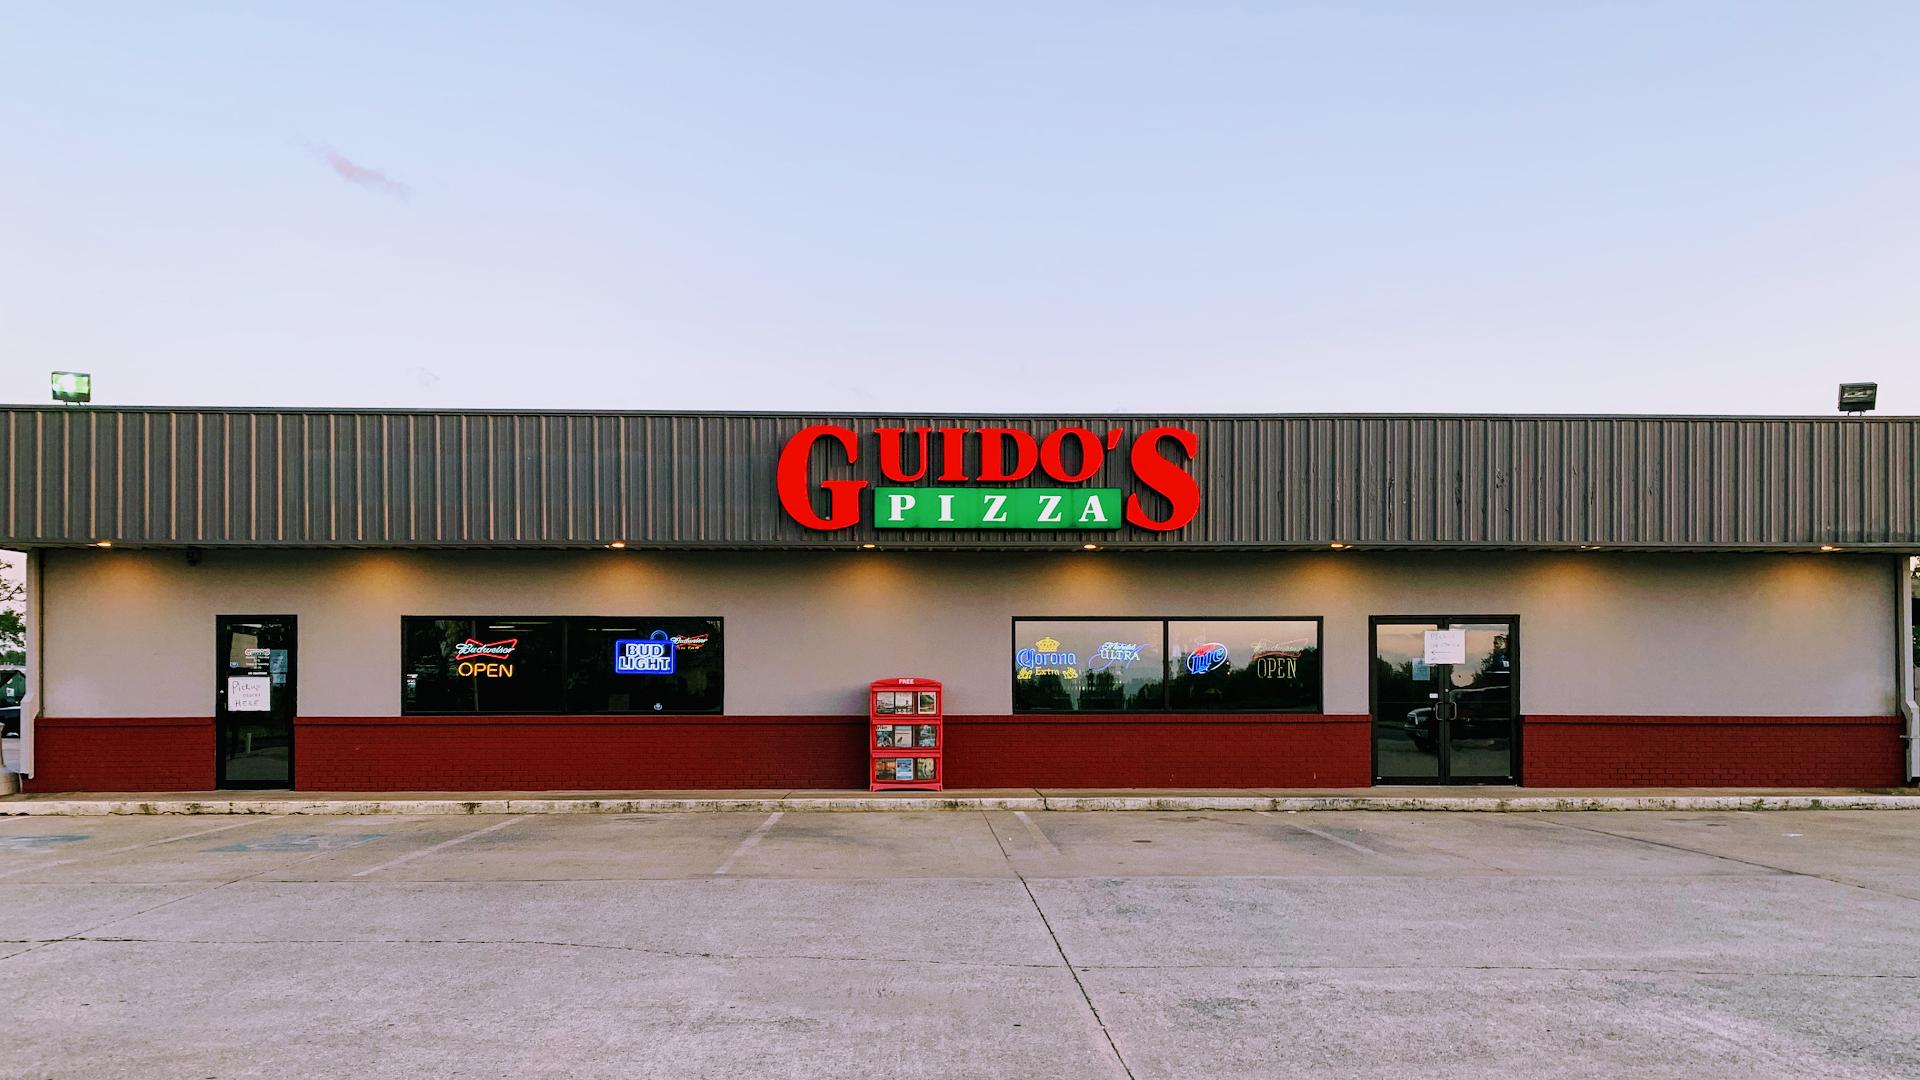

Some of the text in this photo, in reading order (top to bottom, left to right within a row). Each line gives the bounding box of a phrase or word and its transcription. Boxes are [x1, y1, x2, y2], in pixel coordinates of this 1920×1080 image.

[777, 425, 1201, 531] GUIDO'S
[888, 494, 1109, 522] PIZZA
[455, 643, 516, 655] Budweiser
[625, 643, 665, 657] BUD
[1099, 649, 1141, 661] ULTRA
[1015, 648, 1077, 669] Corona
[458, 662, 513, 677] OPEN
[1034, 666, 1060, 676] Extra
[1257, 657, 1298, 679] OPEN
